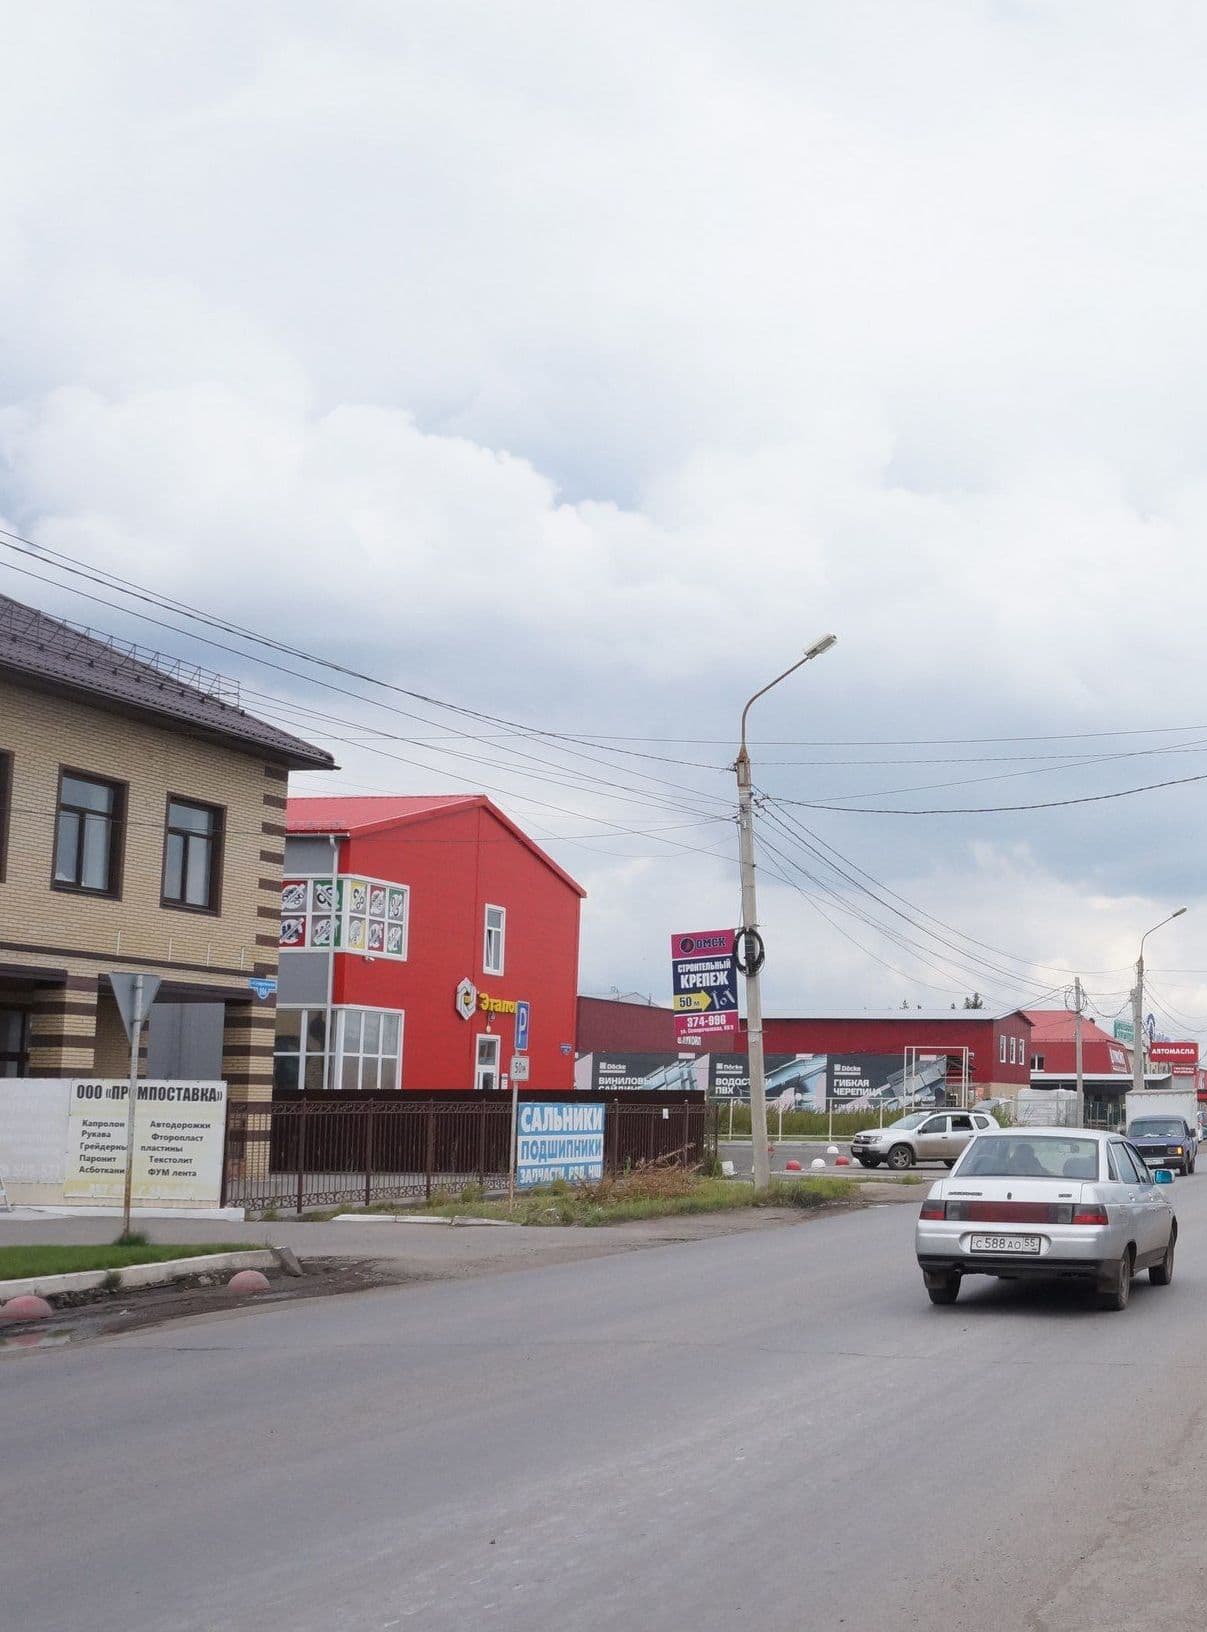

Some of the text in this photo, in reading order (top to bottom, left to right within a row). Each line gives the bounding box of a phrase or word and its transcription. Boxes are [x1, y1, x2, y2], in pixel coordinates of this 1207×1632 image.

[677, 958, 731, 973] СТРОИТЕЛЬНЫЙ
[680, 971, 729, 989] КРЕПЕЖ
[679, 996, 692, 1007] 50
[1151, 1048, 1195, 1056] АВТОМАСЛА
[833, 1079, 870, 1088] ГИБКАЯ
[76, 1084, 223, 1102] ООО «ПРМПОСТАВКА»
[715, 1086, 734, 1095] ПВХ
[833, 1087, 883, 1097] ЧЕРЕПИЦА
[82, 1119, 125, 1129] Капролон
[520, 1106, 603, 1133] САЛЬНИКИ
[150, 1120, 211, 1130] Автодорожки
[81, 1130, 111, 1139] Рукава
[151, 1133, 204, 1142] Фторопласт
[520, 1138, 601, 1163] ПОДШИПНИКИ
[79, 1155, 117, 1163] Паронит
[150, 1155, 193, 1164] Текстолит
[148, 1168, 170, 1177] ФУМ
[1024, 1238, 1036, 1247] 55
